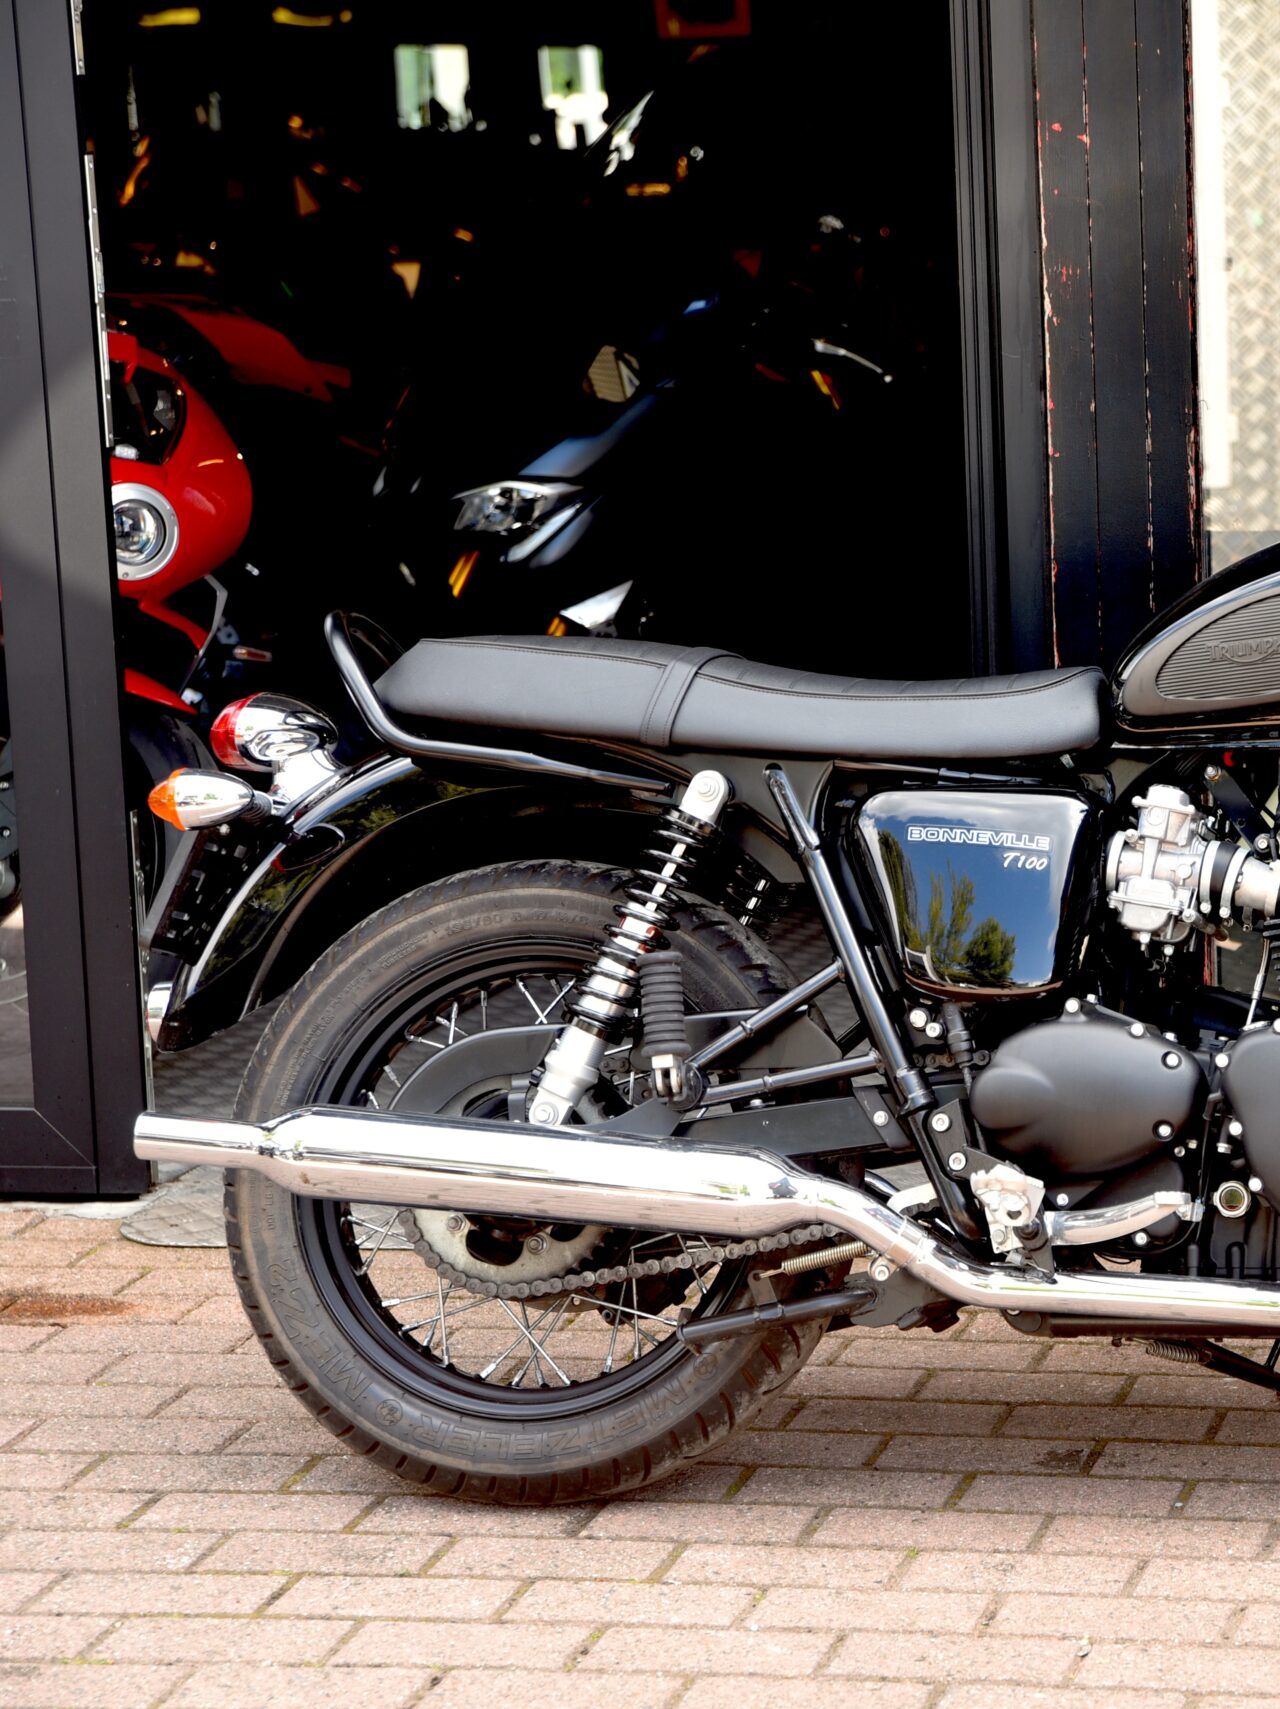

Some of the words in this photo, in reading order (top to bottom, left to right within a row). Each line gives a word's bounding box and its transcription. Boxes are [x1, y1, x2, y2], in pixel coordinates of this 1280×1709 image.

[907, 826, 1050, 850] BONNEVILLE
[1002, 852, 1048, 871] T100
[412, 1376, 690, 1460] METZELER
